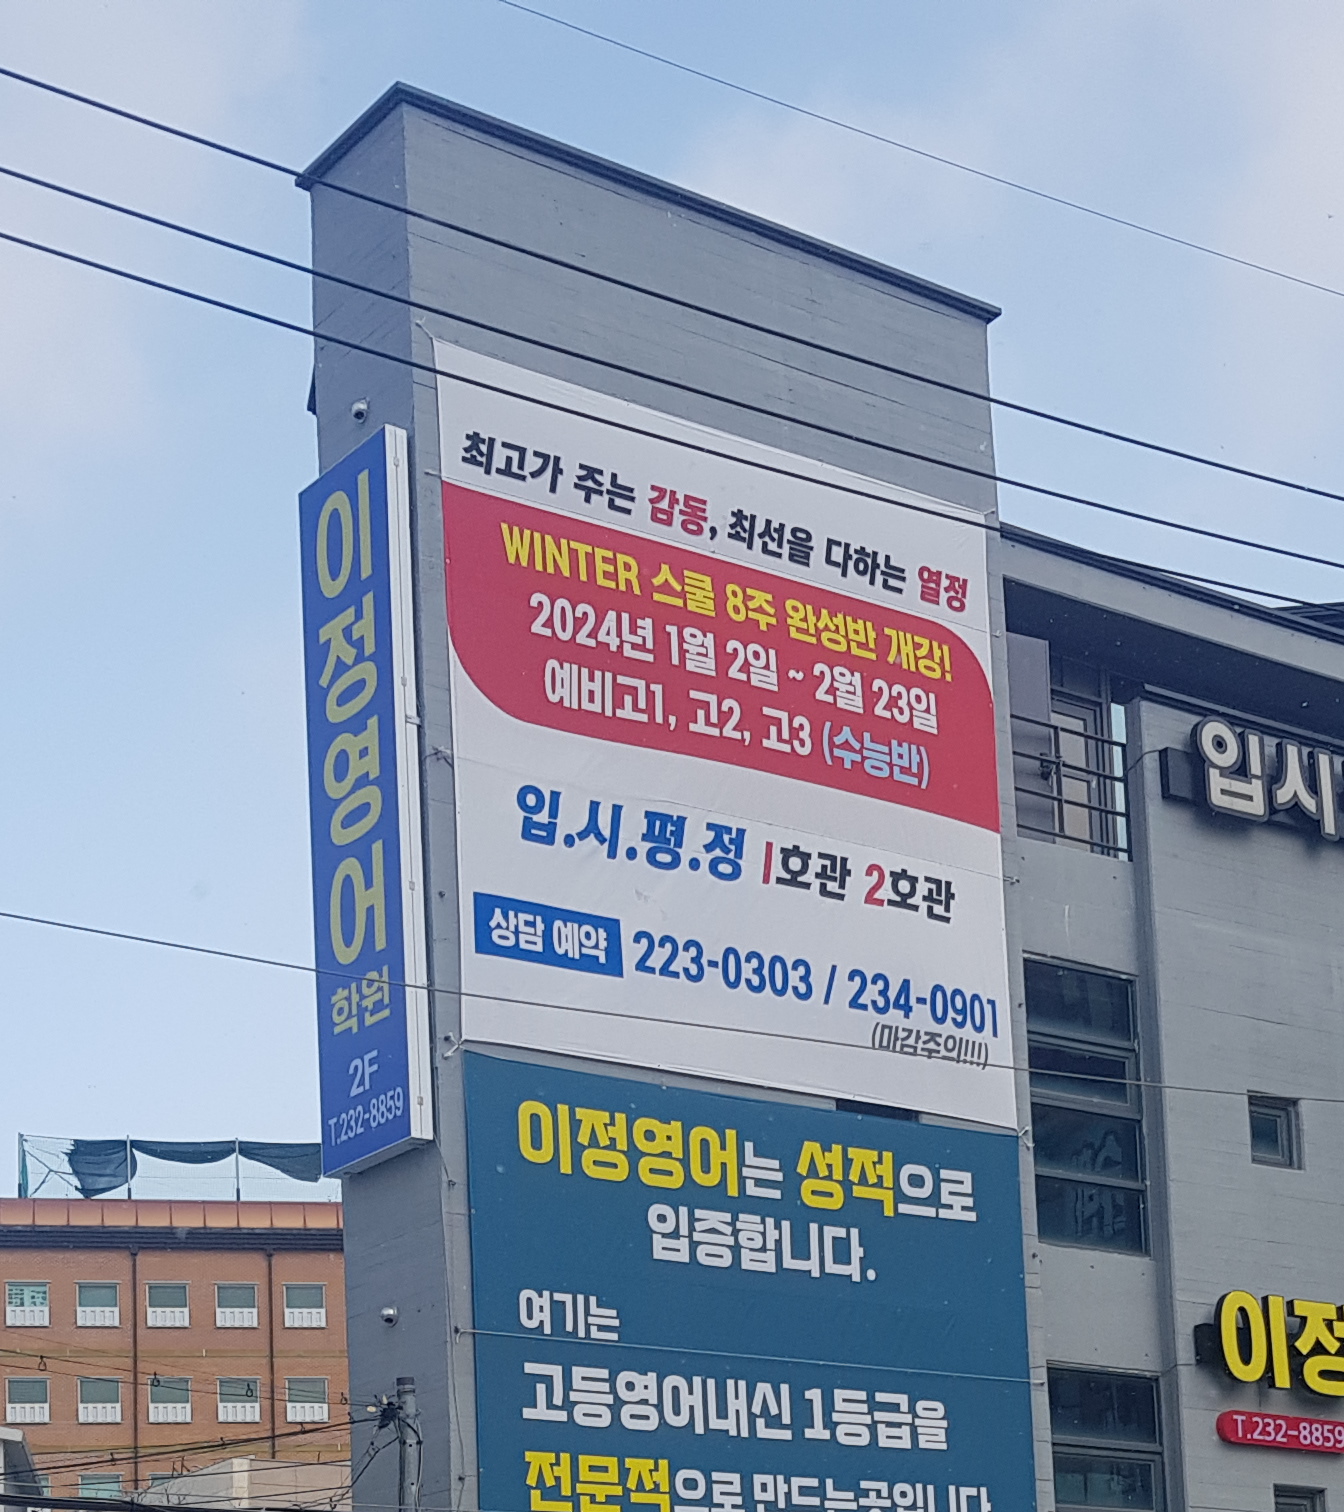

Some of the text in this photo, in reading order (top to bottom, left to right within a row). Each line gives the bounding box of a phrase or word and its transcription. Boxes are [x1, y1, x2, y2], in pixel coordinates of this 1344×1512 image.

[461, 430, 969, 613] 최고가 주는 감동, 최선을 다하는 열정
[499, 522, 953, 683] WINTER 스쿨 8주 완성반 개강!
[529, 592, 655, 663] 2024년
[665, 623, 716, 675] 1월
[724, 637, 778, 693] 2일
[812, 661, 864, 717] 2월
[871, 676, 939, 735] 23일
[315, 467, 387, 967] 이정영어
[543, 657, 931, 791] 예비고1, 고2, 고3 (수능반)
[515, 782, 747, 882] 입.시.평.정
[863, 863, 955, 924] 2호관
[330, 965, 393, 1036] 학원
[487, 908, 546, 953] 상담
[552, 921, 609, 965] 예약
[632, 930, 813, 1002] 223-0303
[846, 968, 1000, 1039] 234-0901
[326, 1085, 405, 1149] T.232-8859
[348, 1048, 381, 1100] 2F
[516, 1099, 979, 1223] 이정영어는 성적으로
[647, 1203, 878, 1283] 입증합니다.
[517, 1288, 621, 1342] 여기는
[521, 1361, 950, 1451] 고등영어내신 1등급을
